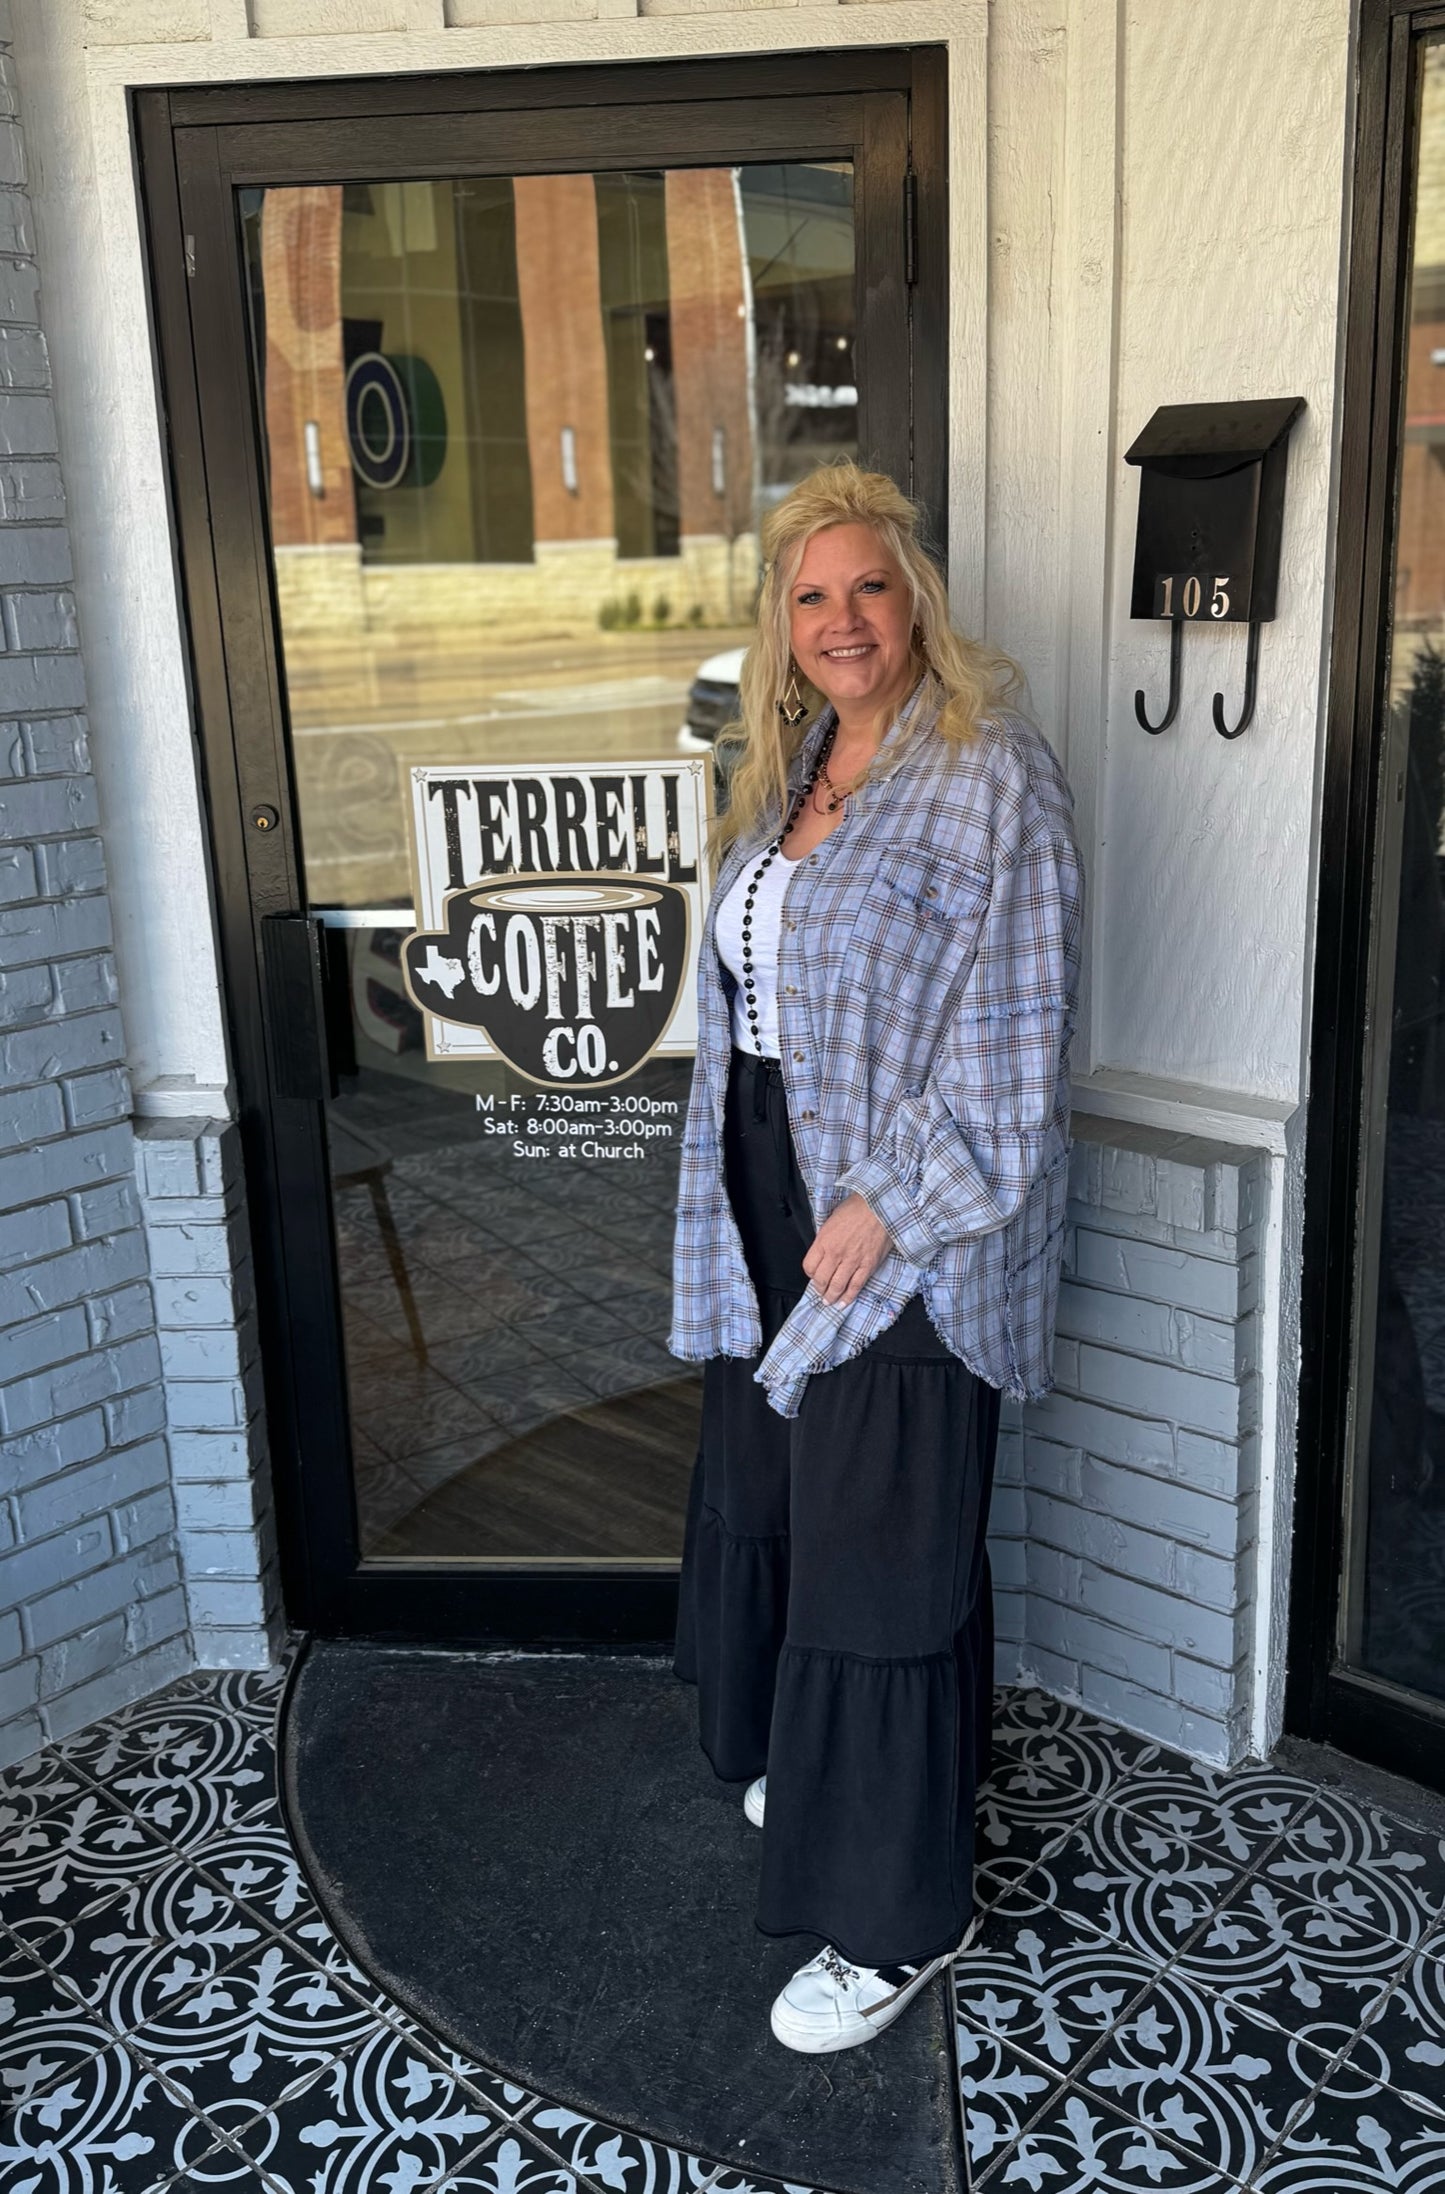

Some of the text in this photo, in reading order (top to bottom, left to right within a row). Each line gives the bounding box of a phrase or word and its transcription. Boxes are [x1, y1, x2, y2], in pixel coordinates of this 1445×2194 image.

[1161, 577, 1230, 618] 105
[429, 775, 698, 890] TERRELL
[467, 908, 664, 1020] COFFEE
[542, 1025, 619, 1078] CO.
[535, 1094, 678, 1116] 7:30am-3:00pm
[484, 1117, 672, 1139] Sat: 8:00am-3:00pm
[513, 1141, 644, 1159] Sun: at Church
